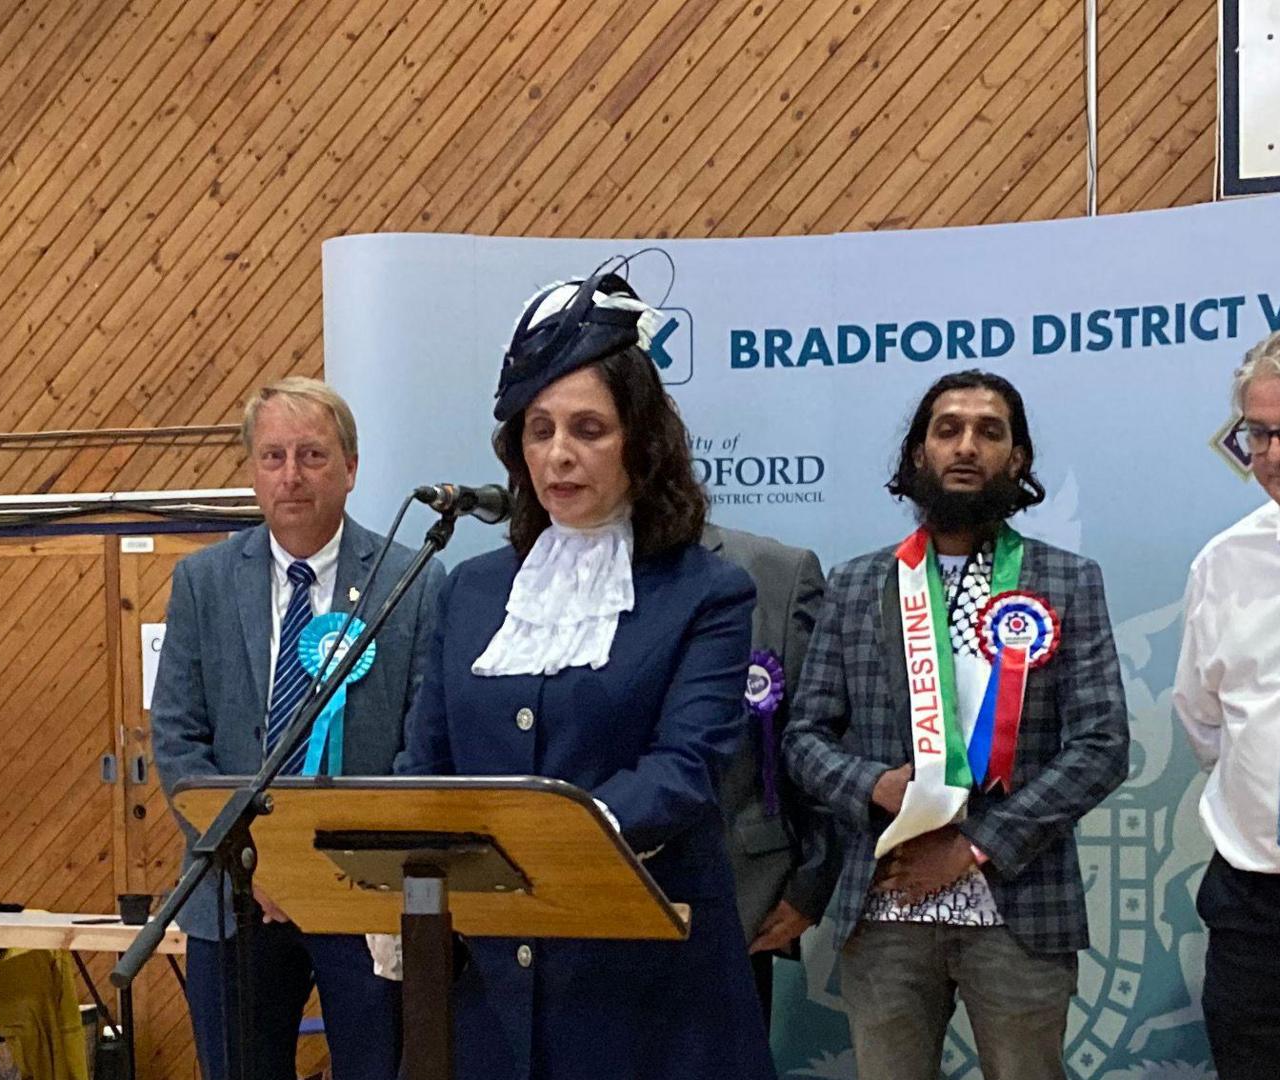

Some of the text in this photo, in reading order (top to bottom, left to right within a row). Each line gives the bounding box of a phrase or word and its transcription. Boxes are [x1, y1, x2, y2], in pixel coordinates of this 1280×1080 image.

[730, 318, 1015, 369] BRADFORD
[1032, 296, 1246, 355] DISTRICT
[688, 432, 741, 454] ity of
[767, 491, 825, 503] COUNCIL
[904, 591, 942, 755] PALESTINE
